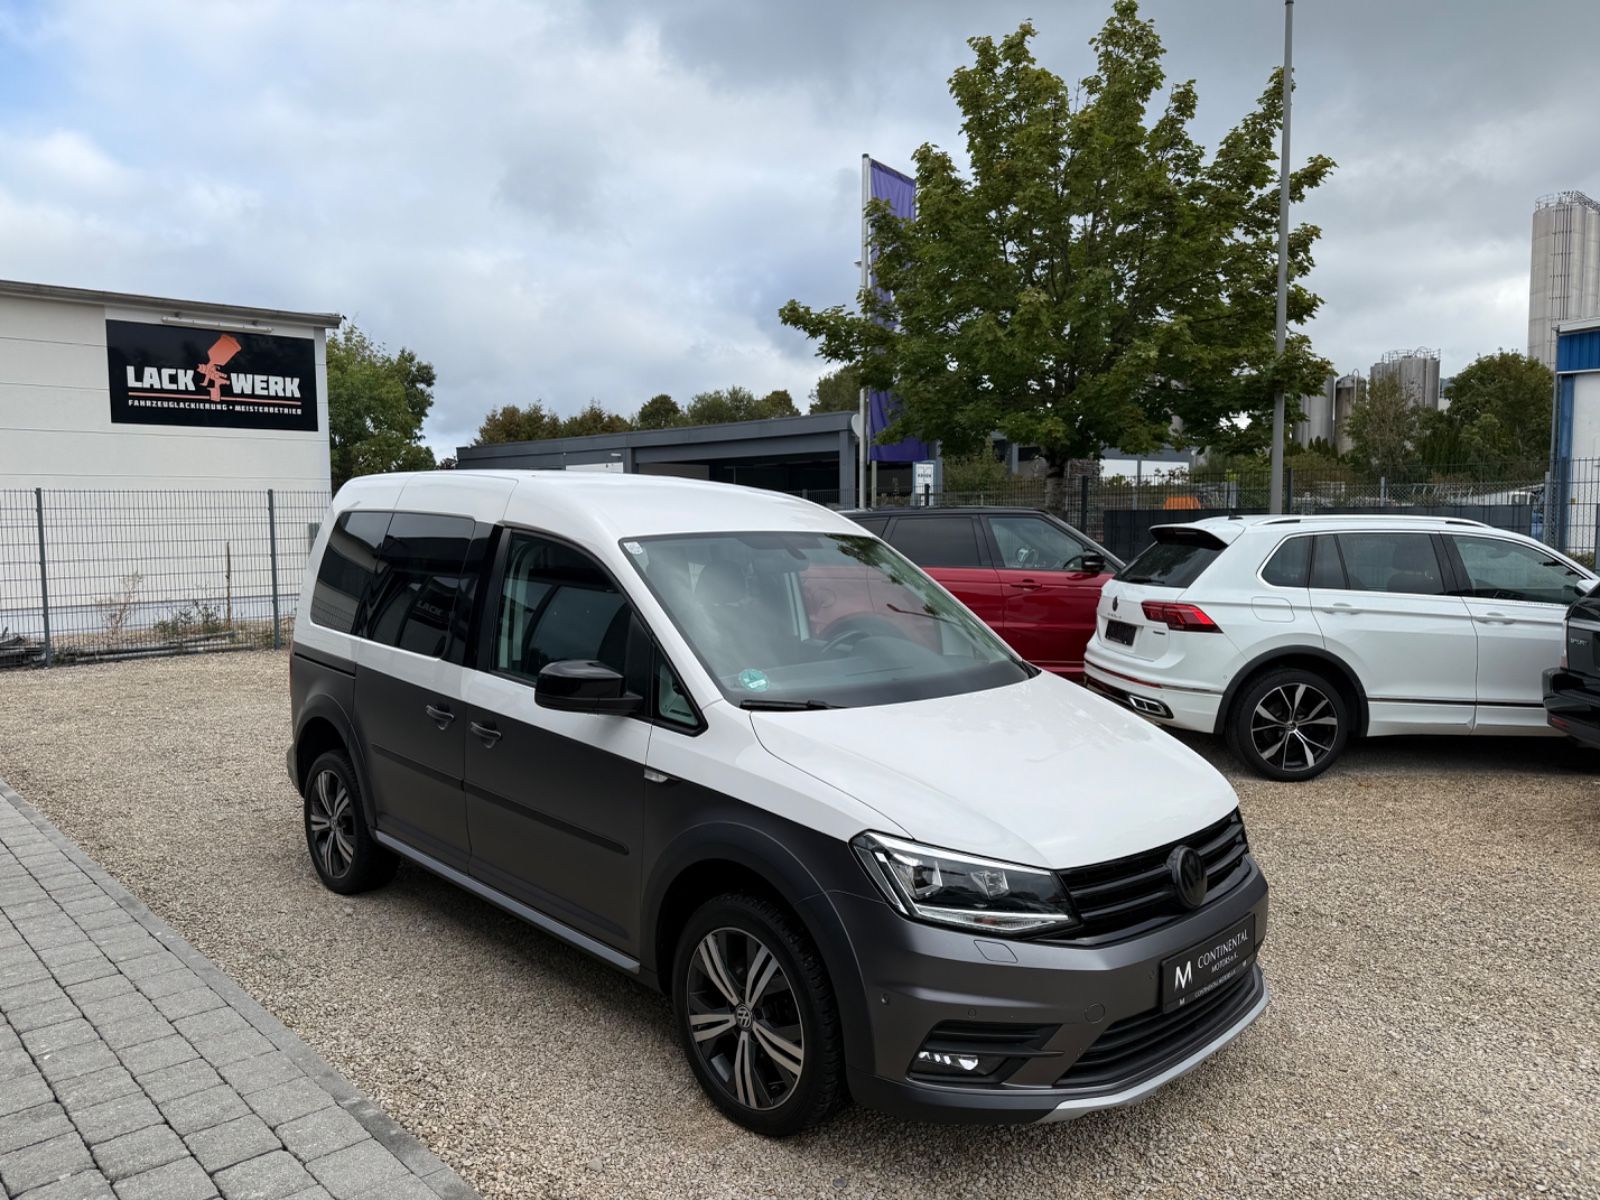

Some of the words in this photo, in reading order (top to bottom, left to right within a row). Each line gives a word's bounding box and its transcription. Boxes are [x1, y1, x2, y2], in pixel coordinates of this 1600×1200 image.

[126, 365, 196, 391] LACK
[230, 372, 301, 398] WERK
[128, 399, 227, 411] FAHRZEUGLACKIERUNG
[234, 405, 302, 415] MEISTERBETRIEB
[1197, 929, 1249, 969] CONTINENTAL
